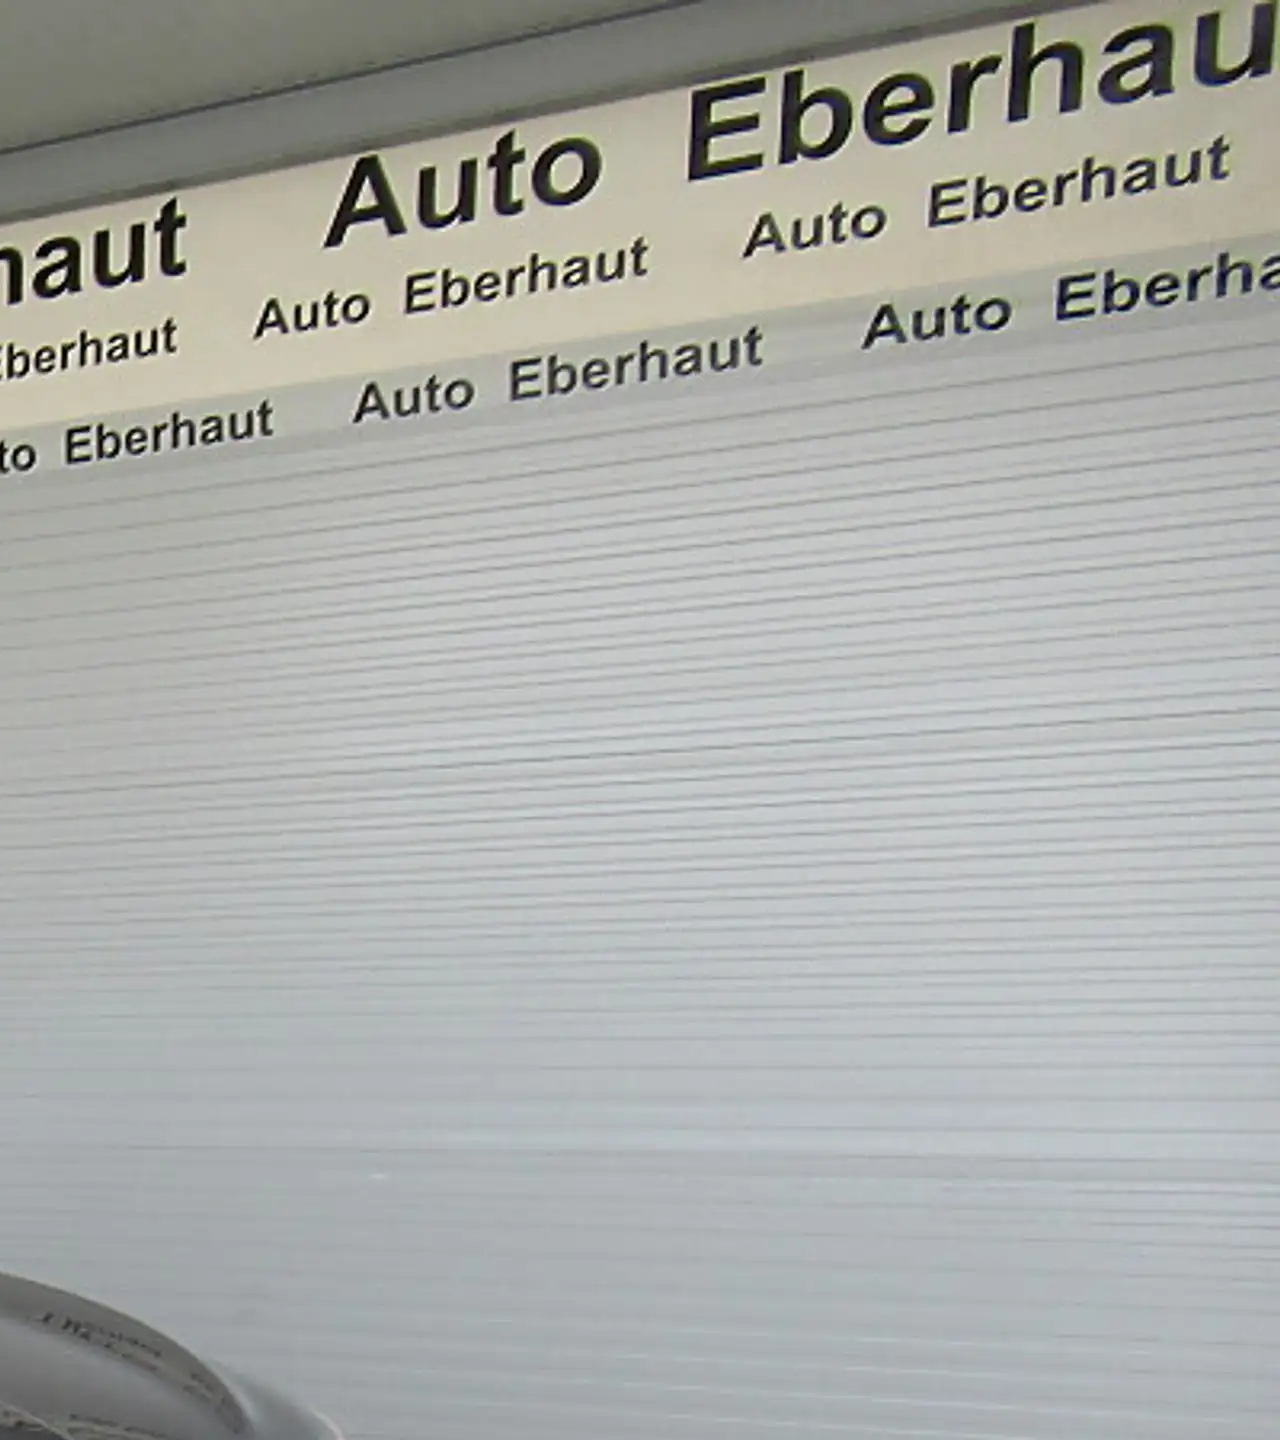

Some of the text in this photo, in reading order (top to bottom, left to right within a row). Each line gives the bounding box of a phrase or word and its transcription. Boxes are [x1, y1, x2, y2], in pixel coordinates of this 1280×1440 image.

[324, 132, 601, 248] Auto
[743, 136, 1229, 258] Auto Eberhaut
[254, 238, 648, 338] Auto Eberhaut
[862, 296, 1011, 349] Auto
[353, 327, 762, 423] Auto Eberhaut
[66, 401, 272, 464] Eberhaut
